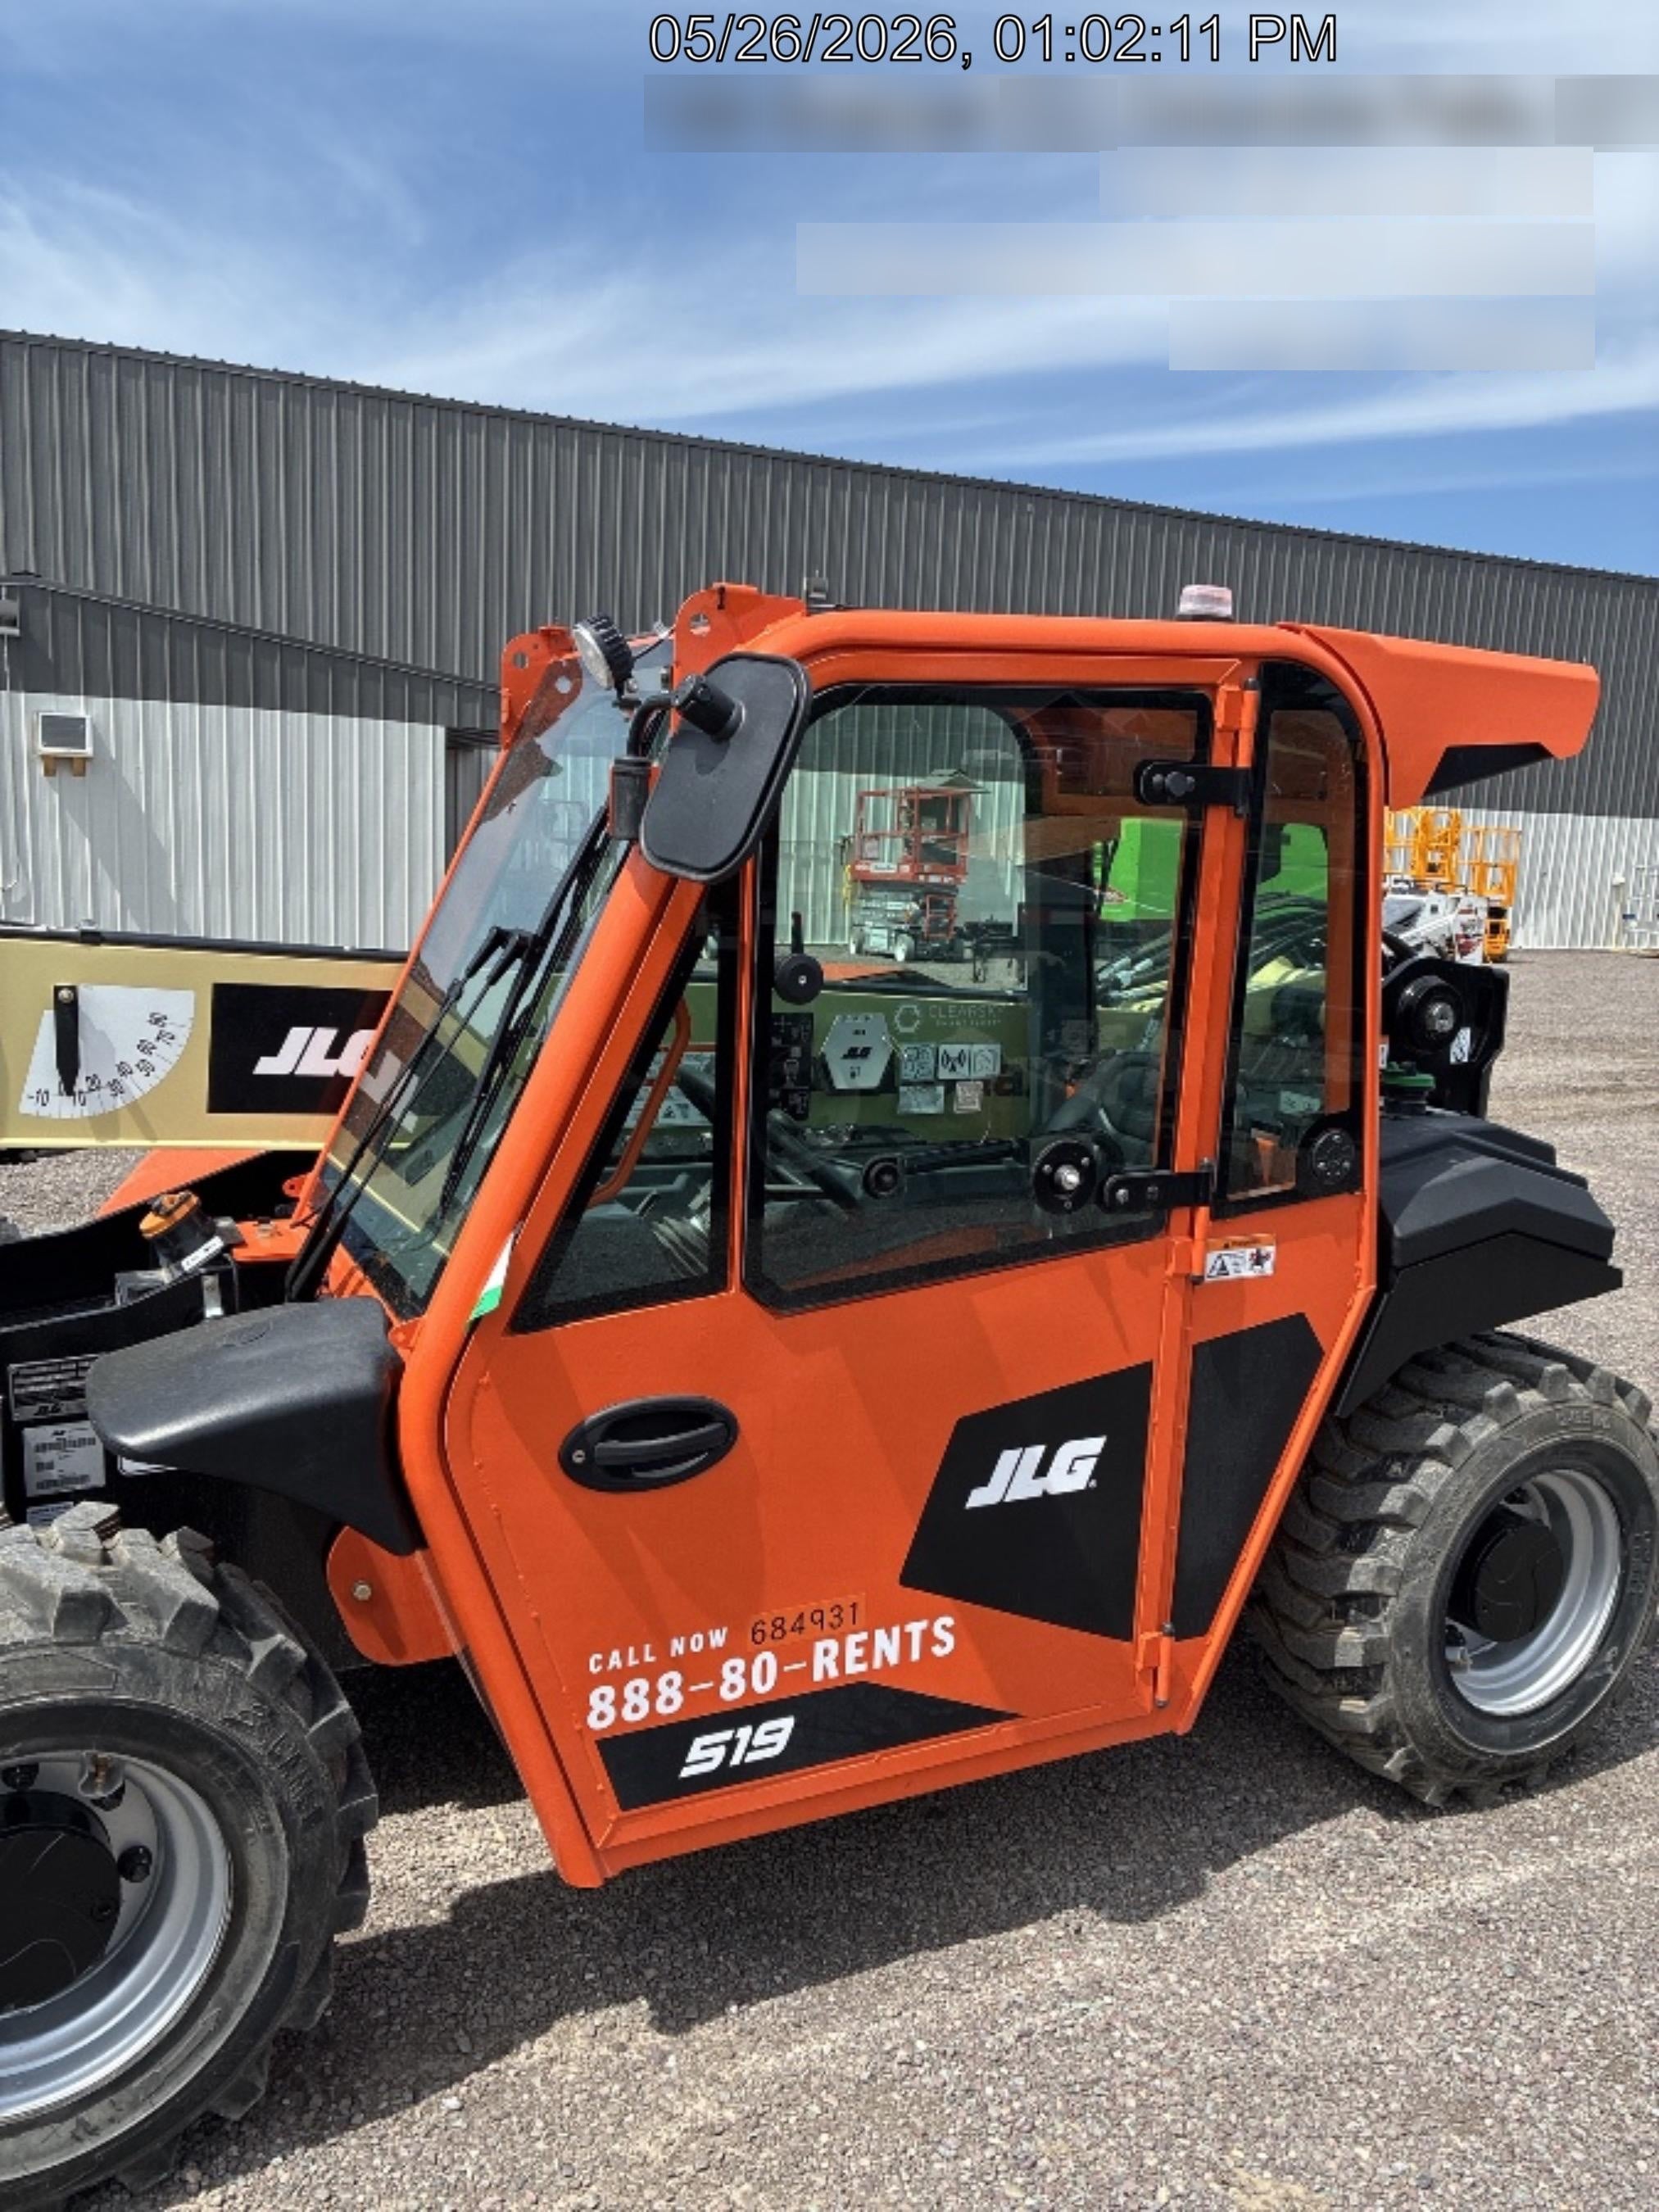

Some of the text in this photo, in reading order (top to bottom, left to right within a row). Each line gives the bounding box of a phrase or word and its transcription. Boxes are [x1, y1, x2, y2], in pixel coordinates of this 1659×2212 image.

[156, 1029, 176, 1046] 70
[841, 1046, 873, 1060] JLG
[28, 1088, 50, 1107] -10
[85, 1073, 102, 1092] 20
[72, 1090, 87, 1107] 10
[964, 1435, 1108, 1509] JLG
[750, 1601, 859, 1645] 684931
[588, 1626, 728, 1674] CALL NOW
[587, 1616, 956, 1731] 888-80-RENTS
[678, 1715, 796, 1779] 519
